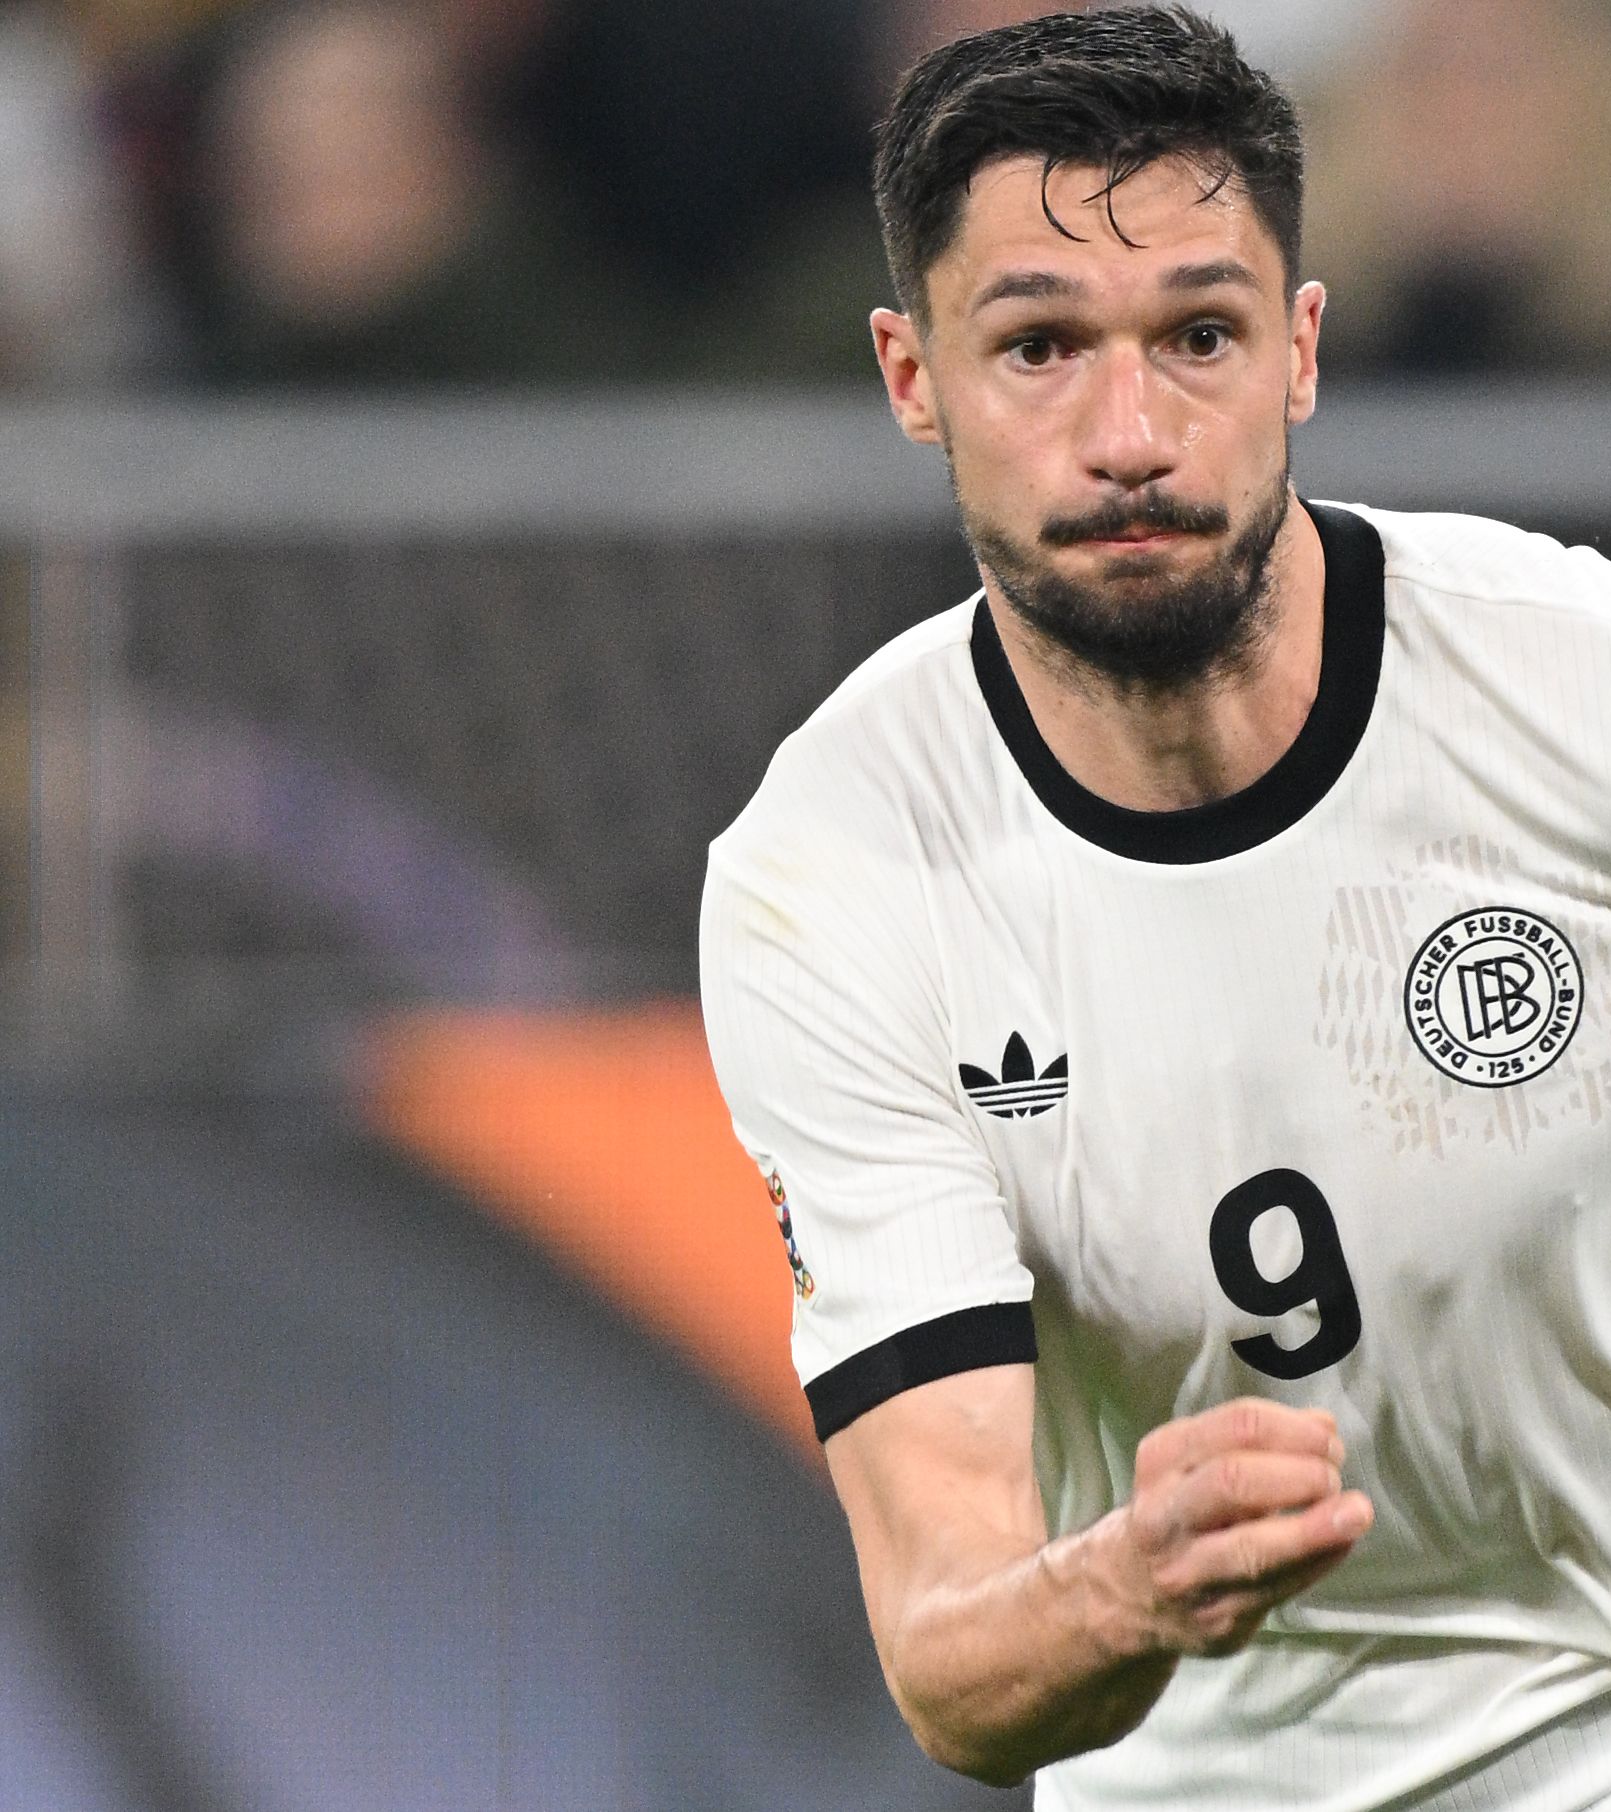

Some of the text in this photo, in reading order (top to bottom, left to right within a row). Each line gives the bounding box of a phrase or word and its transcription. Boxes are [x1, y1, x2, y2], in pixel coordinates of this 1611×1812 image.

[1414, 916, 1575, 1070] DEUTSCHER FUSSBALL-BUND
[1488, 1057, 1525, 1079] 125
[1209, 1167, 1362, 1381] 9
